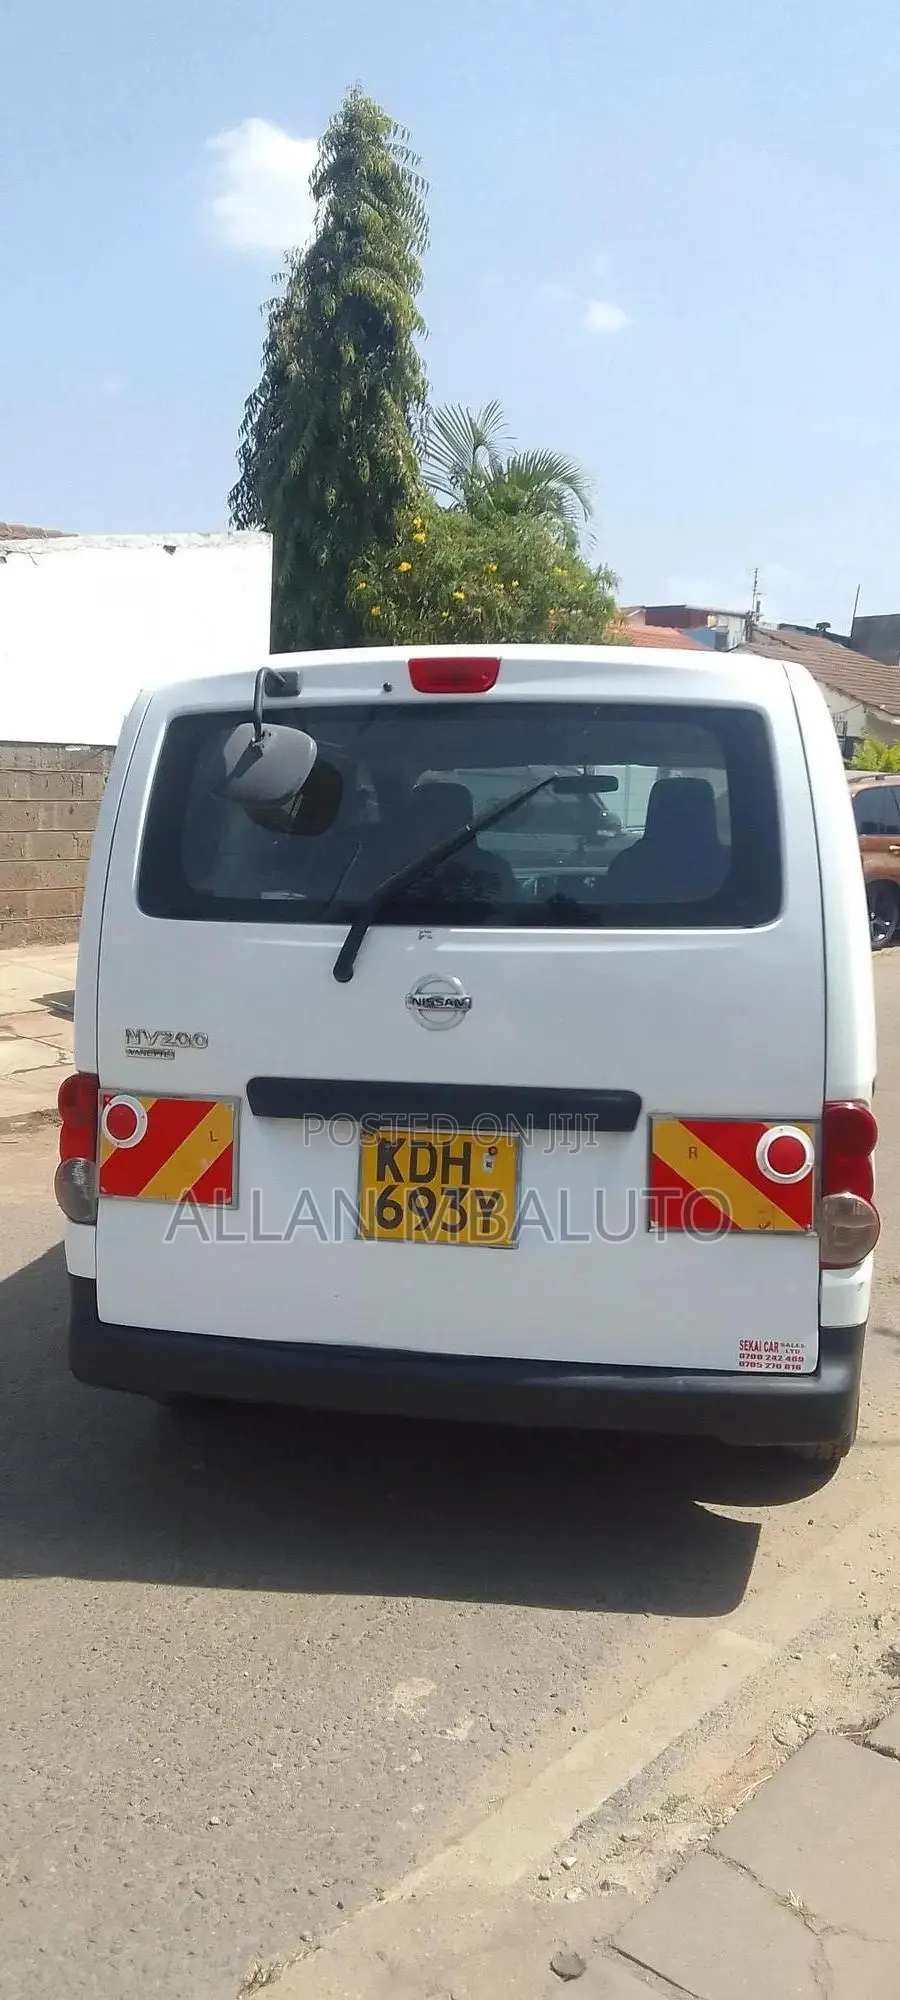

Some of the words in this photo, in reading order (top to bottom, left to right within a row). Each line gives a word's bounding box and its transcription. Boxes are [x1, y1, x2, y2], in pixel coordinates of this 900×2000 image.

[412, 997, 465, 1008] NISSAN
[125, 1028, 208, 1048] NV200
[376, 1138, 471, 1185] KDH
[376, 1184, 500, 1233] 693Y
[739, 1340, 761, 1352] SEKAI
[764, 1341, 779, 1353] CAR
